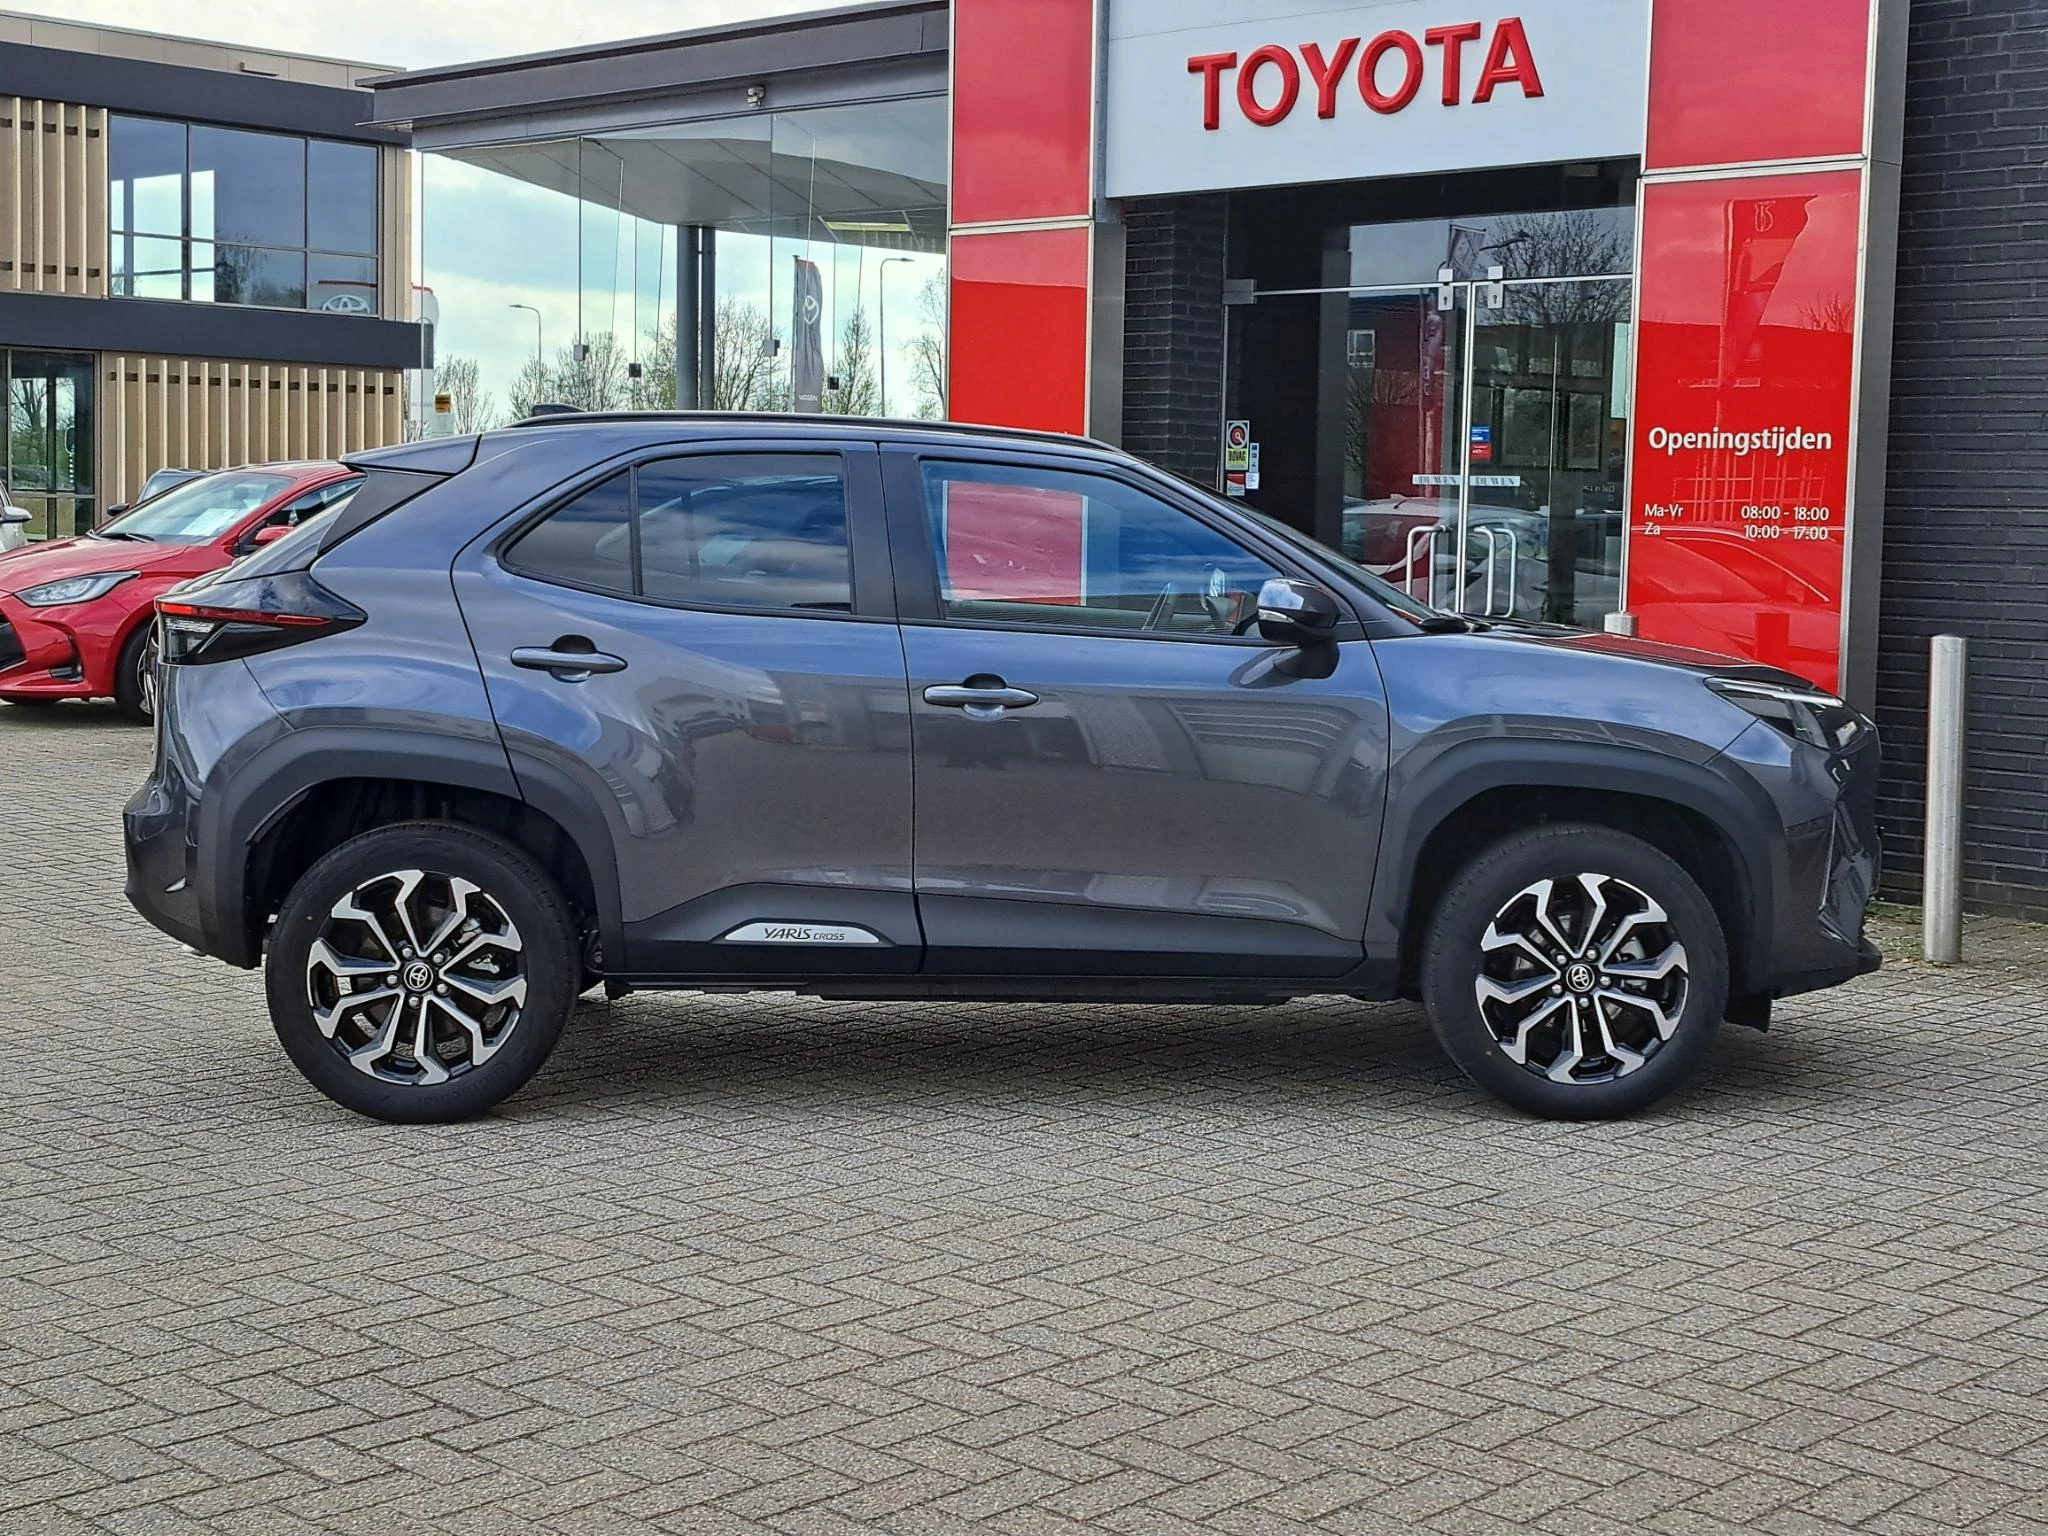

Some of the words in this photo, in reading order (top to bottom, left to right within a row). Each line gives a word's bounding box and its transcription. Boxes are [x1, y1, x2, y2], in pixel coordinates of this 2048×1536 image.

[1187, 17, 1545, 131] TOYOTA
[1648, 426, 1832, 456] Openingstijden
[1228, 450, 1246, 461] BOVAG
[1644, 503, 1684, 517] Ma-Vr
[1740, 505, 1781, 520] 08:00
[1793, 506, 1830, 521] 18:00
[1644, 522, 1661, 535] Za
[1744, 524, 1780, 539] 10:00
[1792, 525, 1829, 540] 17:00
[813, 932, 845, 941] CROSS
